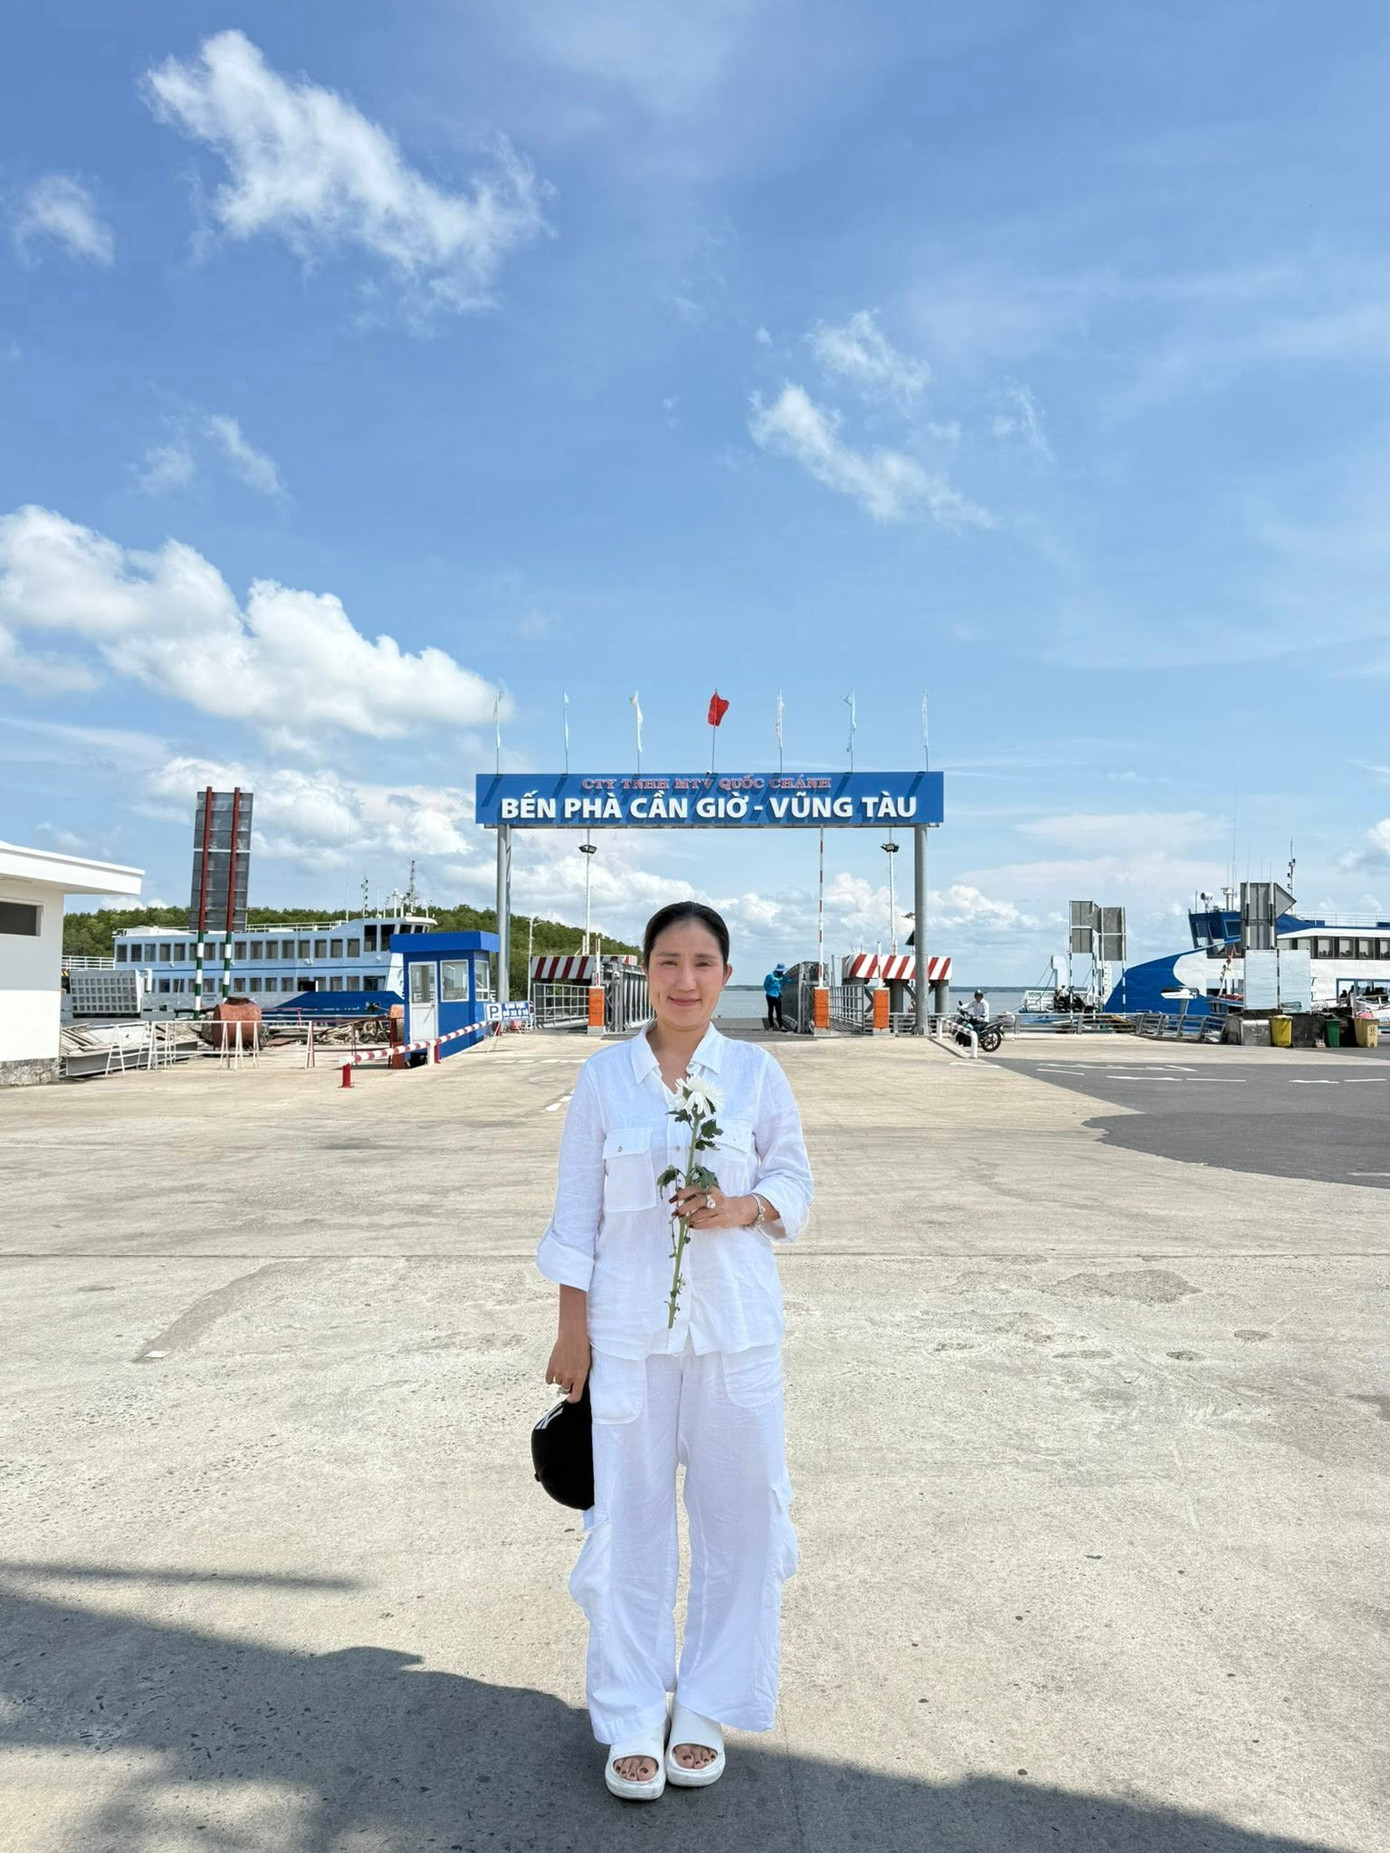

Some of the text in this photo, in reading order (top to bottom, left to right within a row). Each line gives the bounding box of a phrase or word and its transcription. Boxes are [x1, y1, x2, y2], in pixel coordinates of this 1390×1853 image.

[583, 773, 831, 790] CTY TNHH MTV QUỐC CHÁNH
[501, 790, 556, 818] BẾN
[564, 792, 622, 819] PHÀ
[630, 789, 688, 819] CẦN
[696, 791, 750, 819] GIỜ
[769, 792, 853, 819] VŨNG
[861, 790, 917, 818] TÀU
[489, 1006, 499, 1019] P
